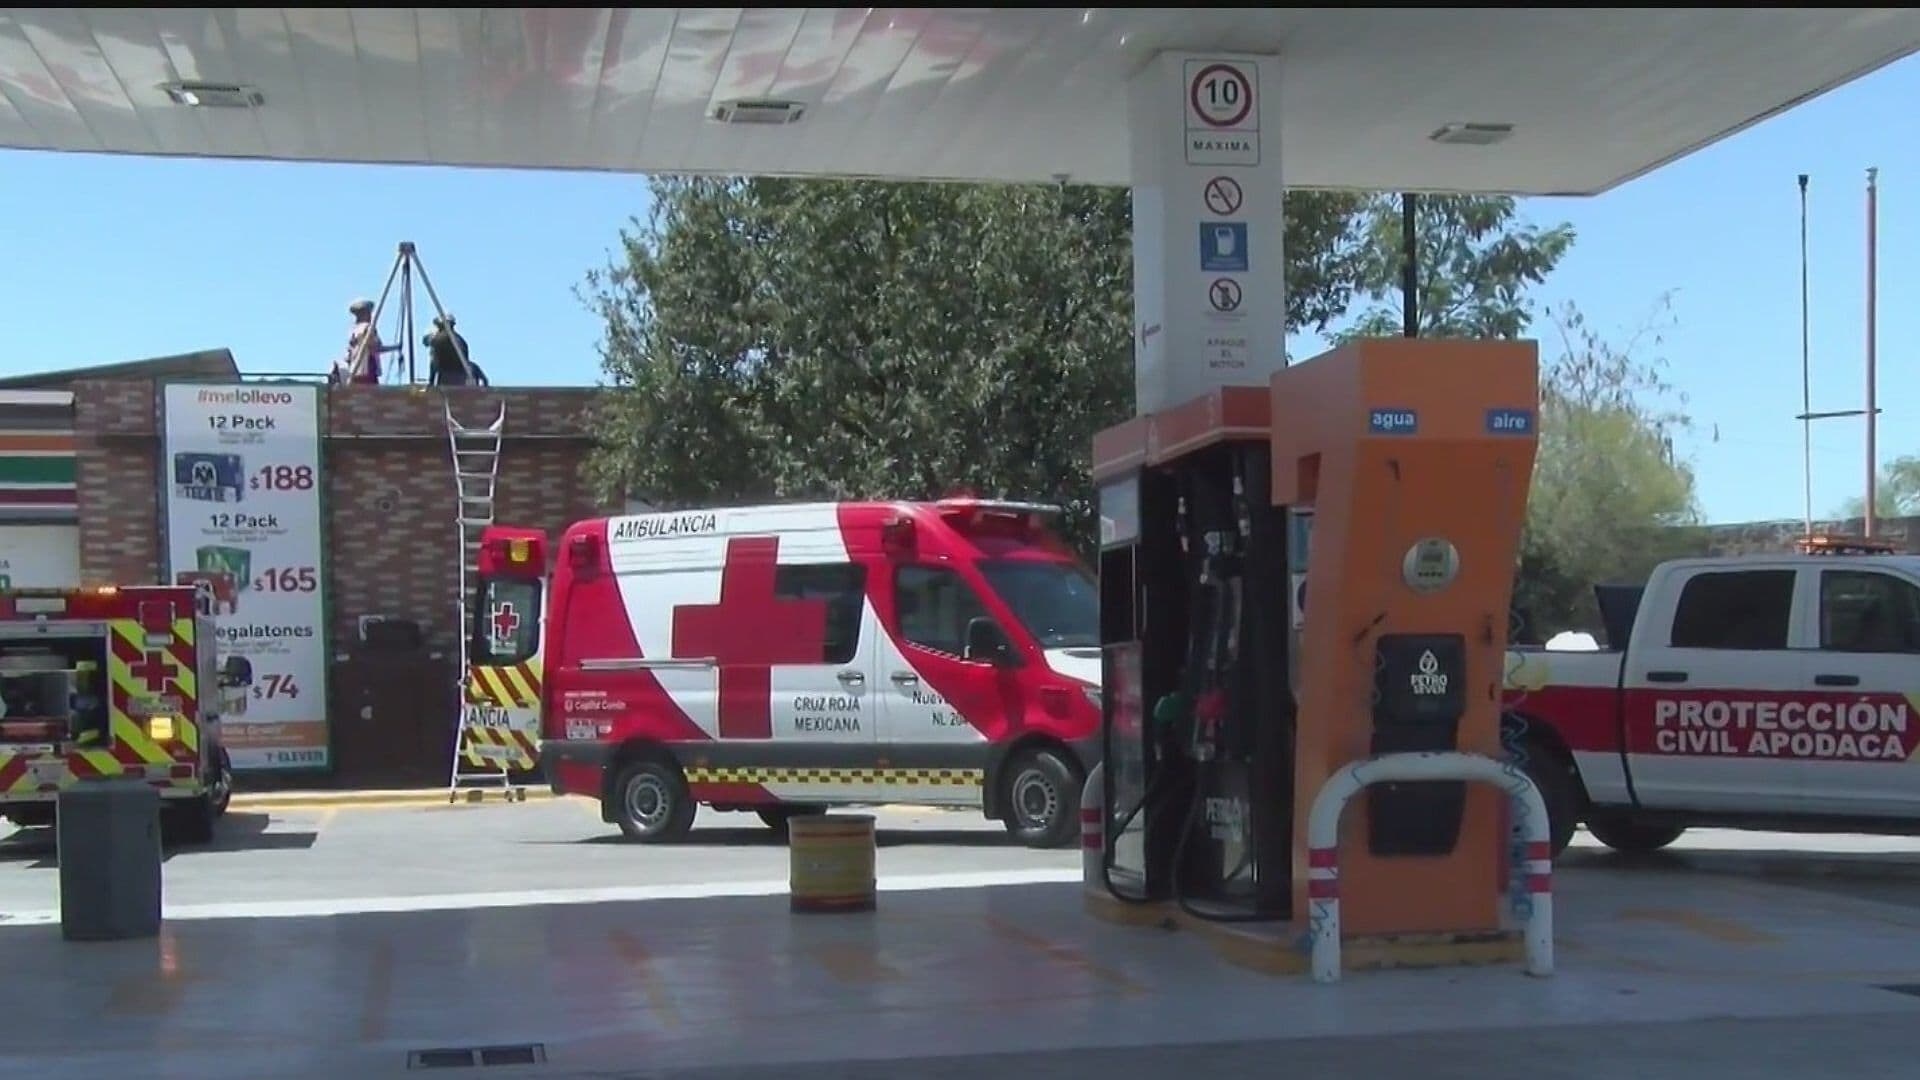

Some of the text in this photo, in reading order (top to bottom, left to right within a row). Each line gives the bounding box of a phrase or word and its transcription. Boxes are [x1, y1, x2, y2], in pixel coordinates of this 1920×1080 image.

[1204, 78, 1239, 105] 10
[1193, 140, 1251, 151] MAXIMA
[197, 388, 293, 405] #melollevo
[208, 414, 276, 430] 12 Pack
[1372, 412, 1415, 429] agua
[1493, 412, 1527, 429] aire
[250, 464, 314, 491] $188
[210, 513, 278, 528] 12 Pack
[614, 513, 717, 538] AMBULANCIA
[254, 567, 317, 593] $165
[215, 624, 313, 641] egalatones
[253, 673, 299, 699] $74
[793, 697, 861, 711] CRUZ ROJA
[1655, 696, 1908, 732] PROTECCIÓN
[794, 717, 861, 732] MEXICANA
[1656, 729, 1906, 759] CIVIL APODACA
